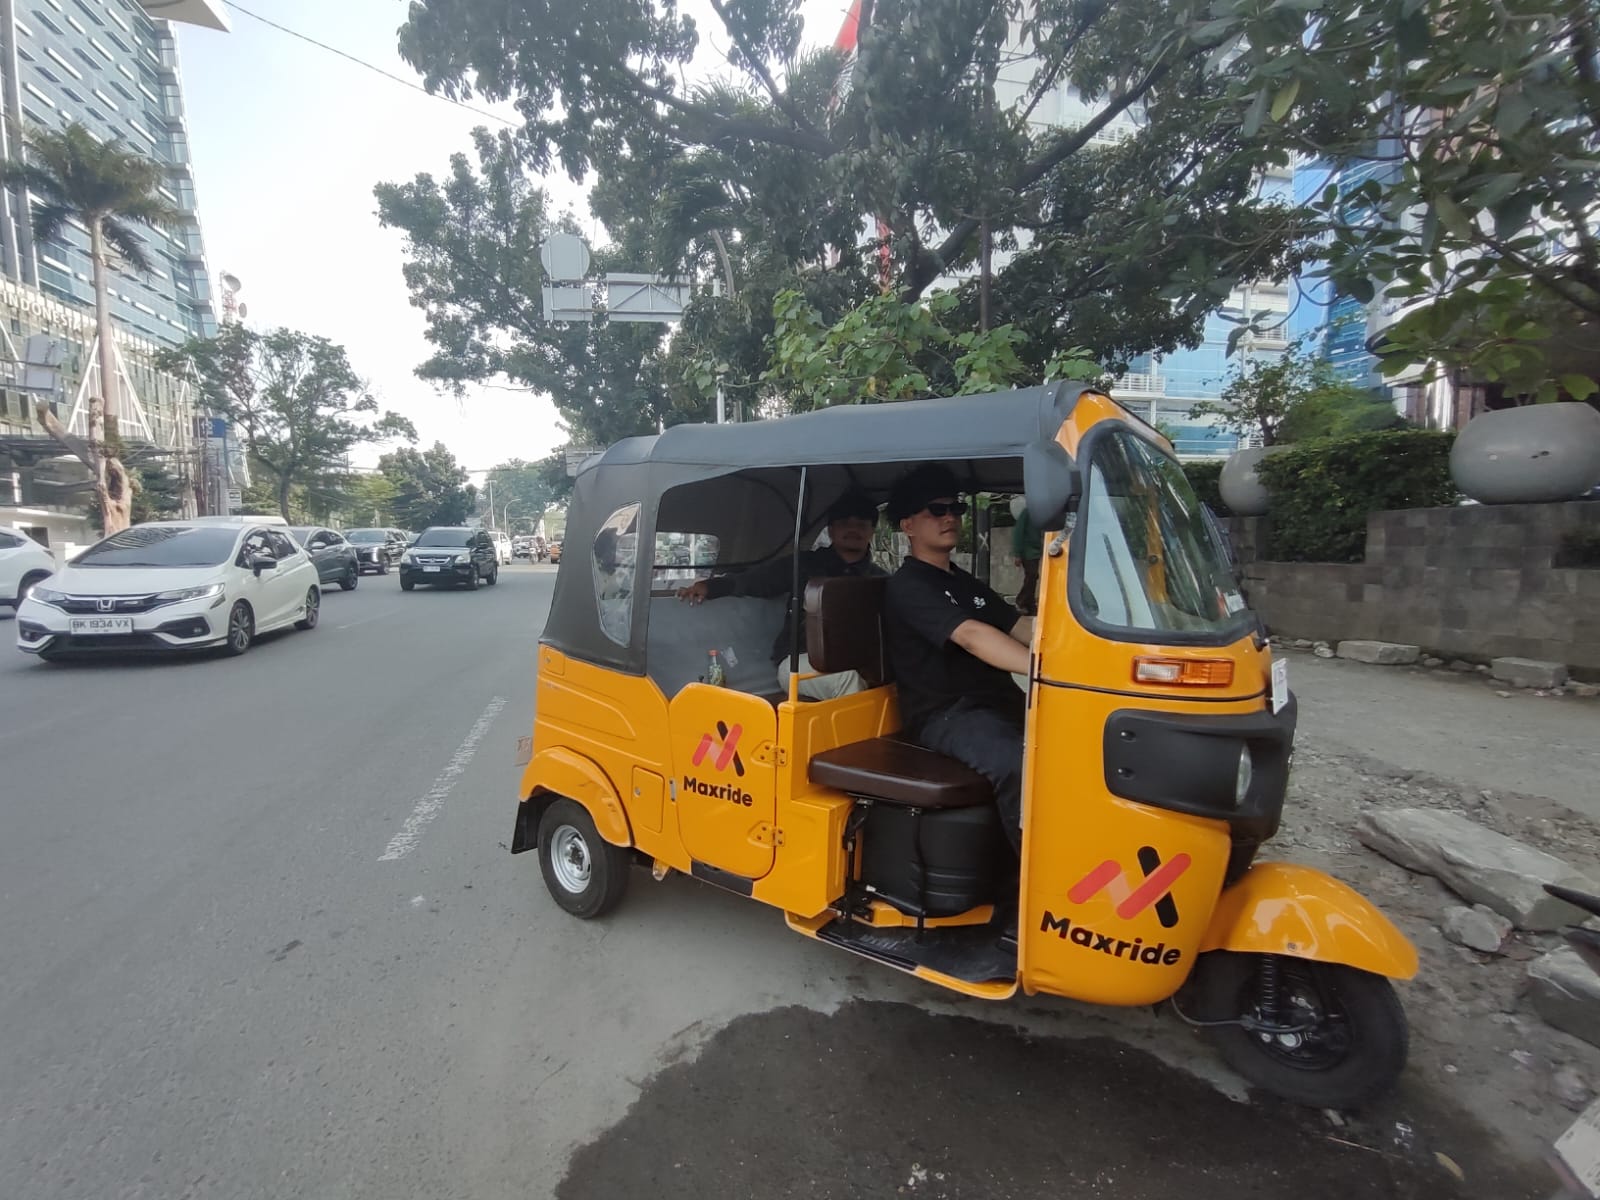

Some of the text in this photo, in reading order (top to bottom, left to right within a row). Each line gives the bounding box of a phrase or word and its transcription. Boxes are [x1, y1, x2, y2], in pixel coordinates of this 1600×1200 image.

[72, 619, 130, 629] BK 1934 VX
[683, 775, 753, 807] Maxride
[1040, 910, 1181, 966] Maxride
